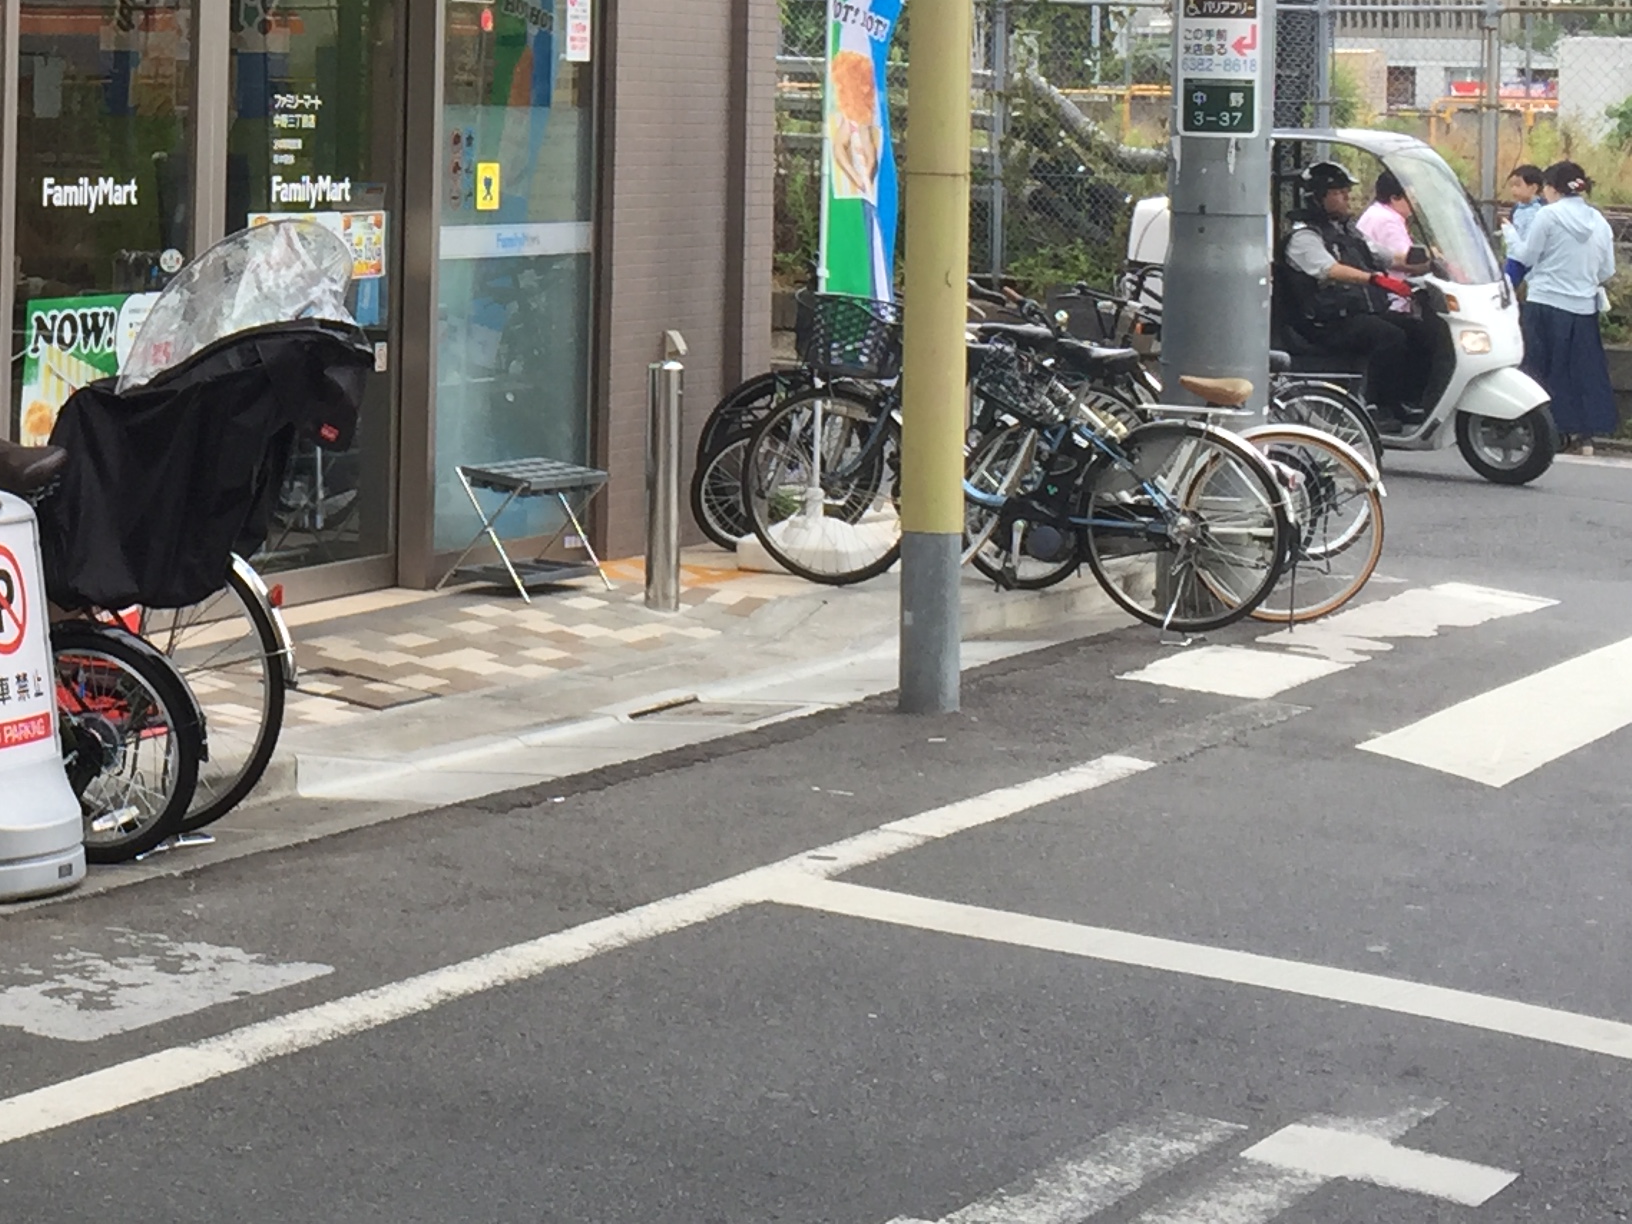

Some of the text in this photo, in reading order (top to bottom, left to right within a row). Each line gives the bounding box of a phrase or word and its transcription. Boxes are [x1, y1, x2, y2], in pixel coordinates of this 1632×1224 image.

[1202, 0, 1255, 15] バリアフリー
[1183, 28, 1228, 42] この手前
[1181, 58, 1257, 73] 6382-8618
[1192, 110, 1243, 127] 3-37
[42, 176, 138, 214] FamilyMart
[271, 176, 351, 209] FamilyMart
[30, 310, 116, 355] NOW!
